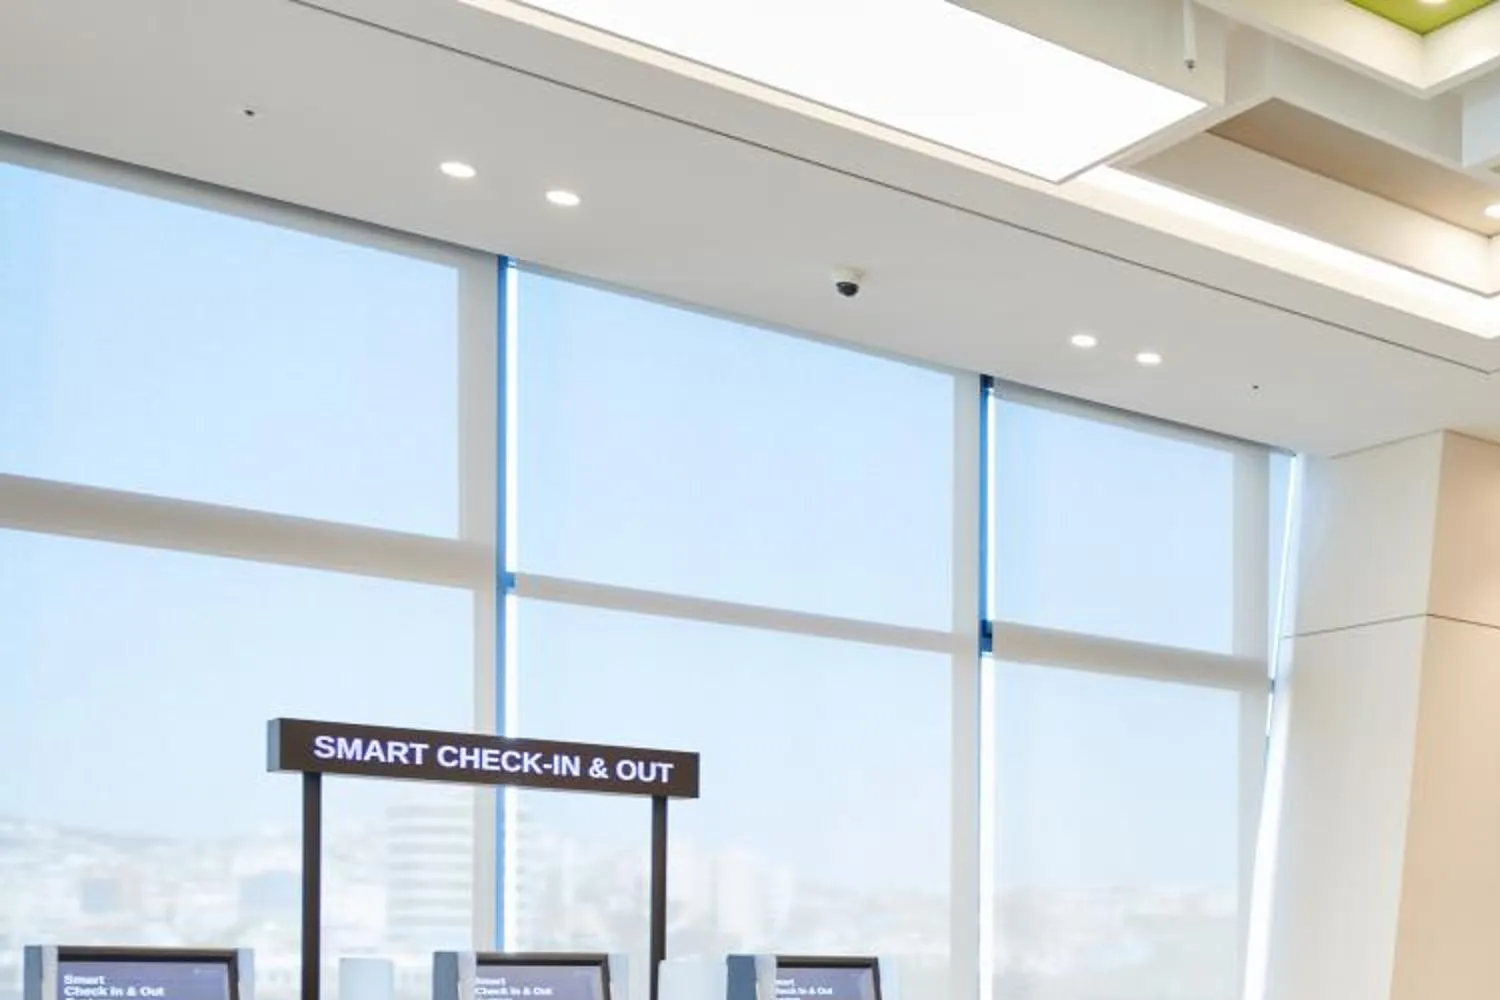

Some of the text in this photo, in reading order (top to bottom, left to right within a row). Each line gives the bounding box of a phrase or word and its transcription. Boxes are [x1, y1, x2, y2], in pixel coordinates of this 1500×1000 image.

[314, 736, 674, 783] SMART CHECK-IN & OUT
[64, 975, 106, 985] Smart
[64, 986, 108, 997] Check
[140, 987, 165, 997] Out
